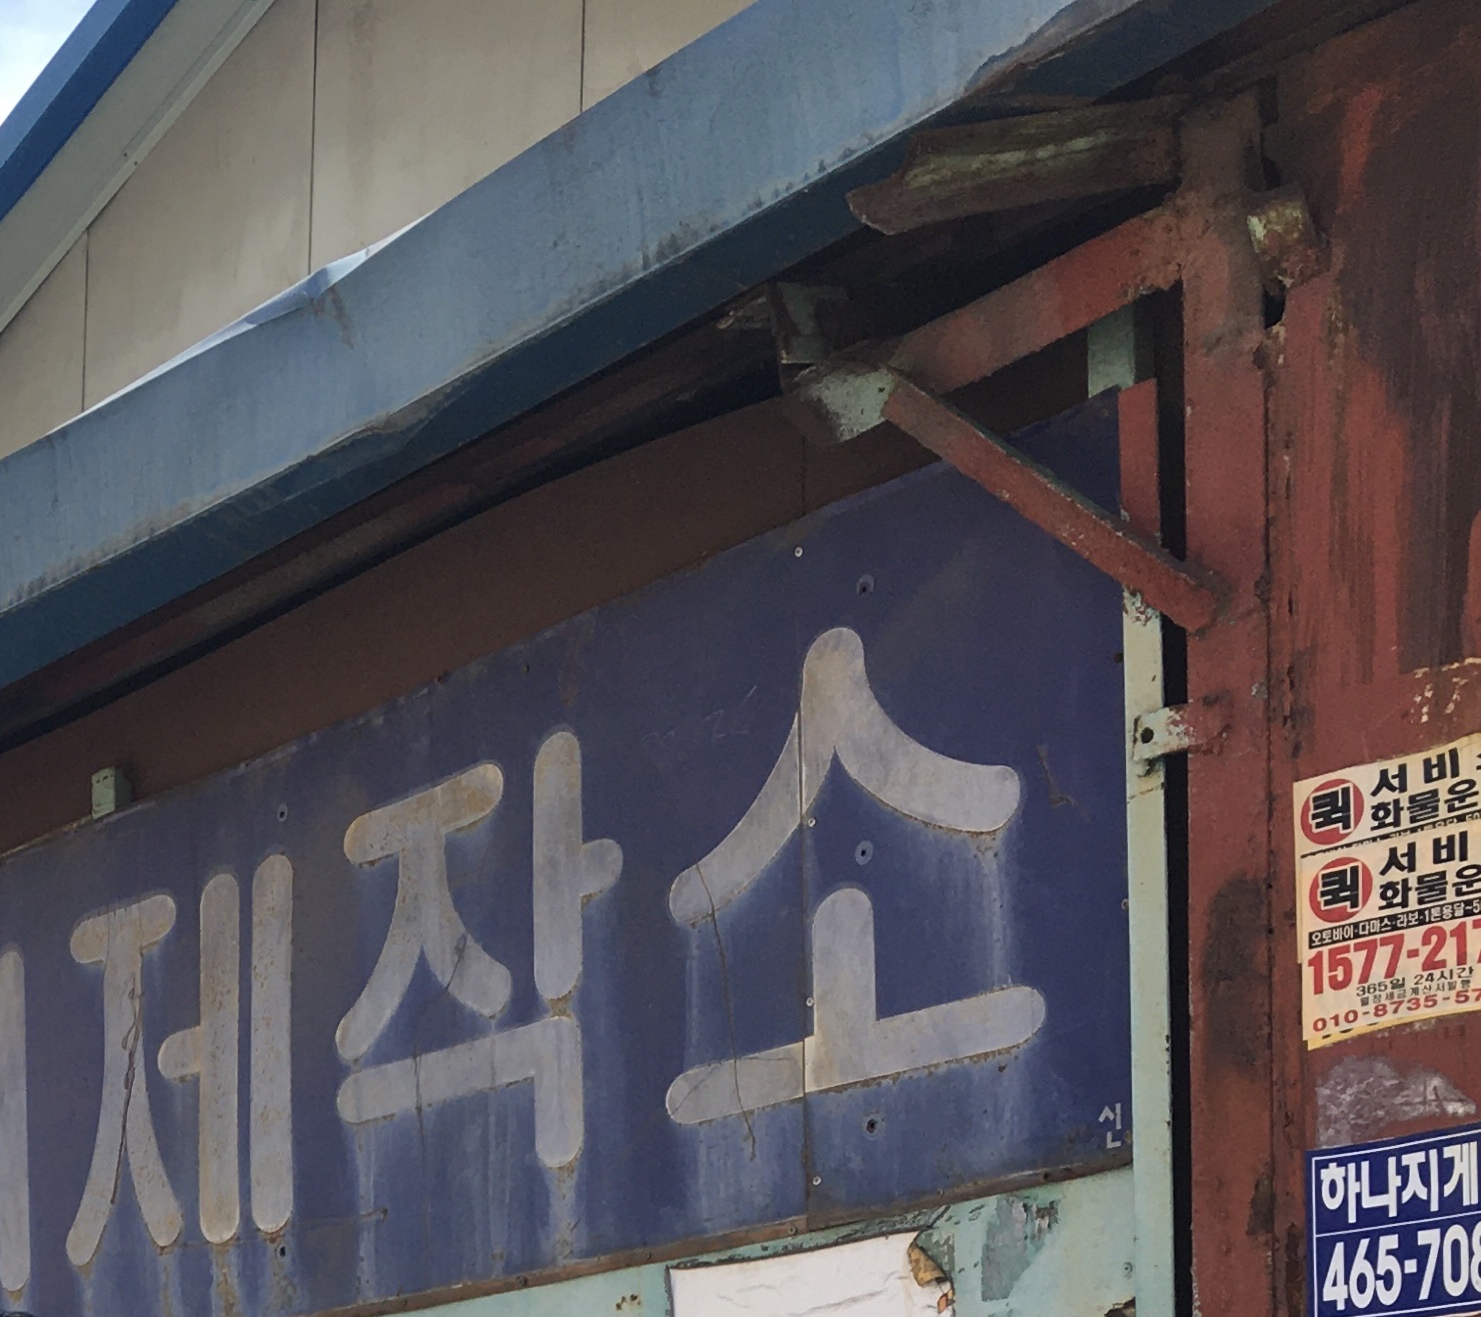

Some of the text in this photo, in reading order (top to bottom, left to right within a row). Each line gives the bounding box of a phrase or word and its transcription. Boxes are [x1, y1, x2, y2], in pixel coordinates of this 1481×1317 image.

[1310, 747, 1481, 832] 퀵 서비
[1319, 864, 1361, 910] 퀵
[1355, 966, 1475, 998] 365일 24시간
[1320, 1140, 1479, 1224] 하나지게
